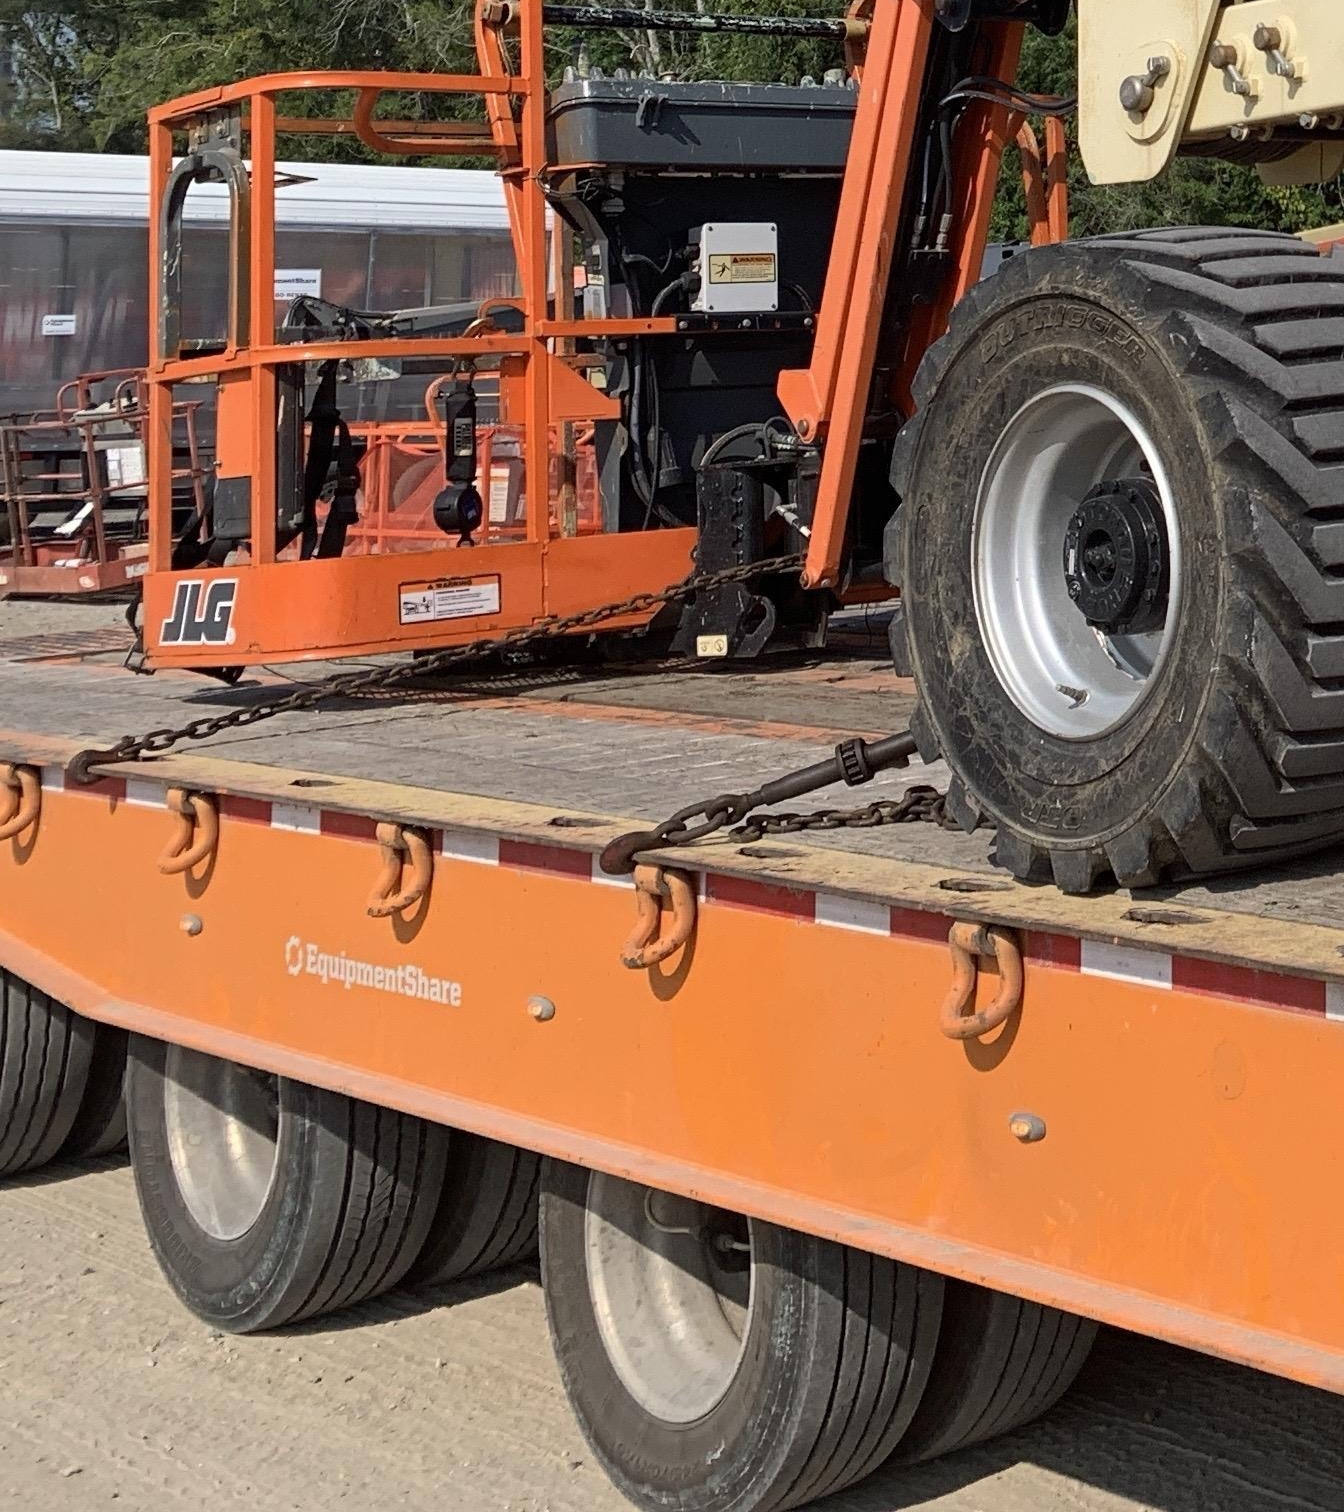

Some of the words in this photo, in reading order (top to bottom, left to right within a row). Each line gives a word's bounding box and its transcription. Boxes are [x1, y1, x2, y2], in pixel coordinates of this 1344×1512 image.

[980, 303, 1147, 369] OUTRIGGER
[159, 580, 239, 645] JLG
[305, 943, 462, 1008] EquipmentShare
